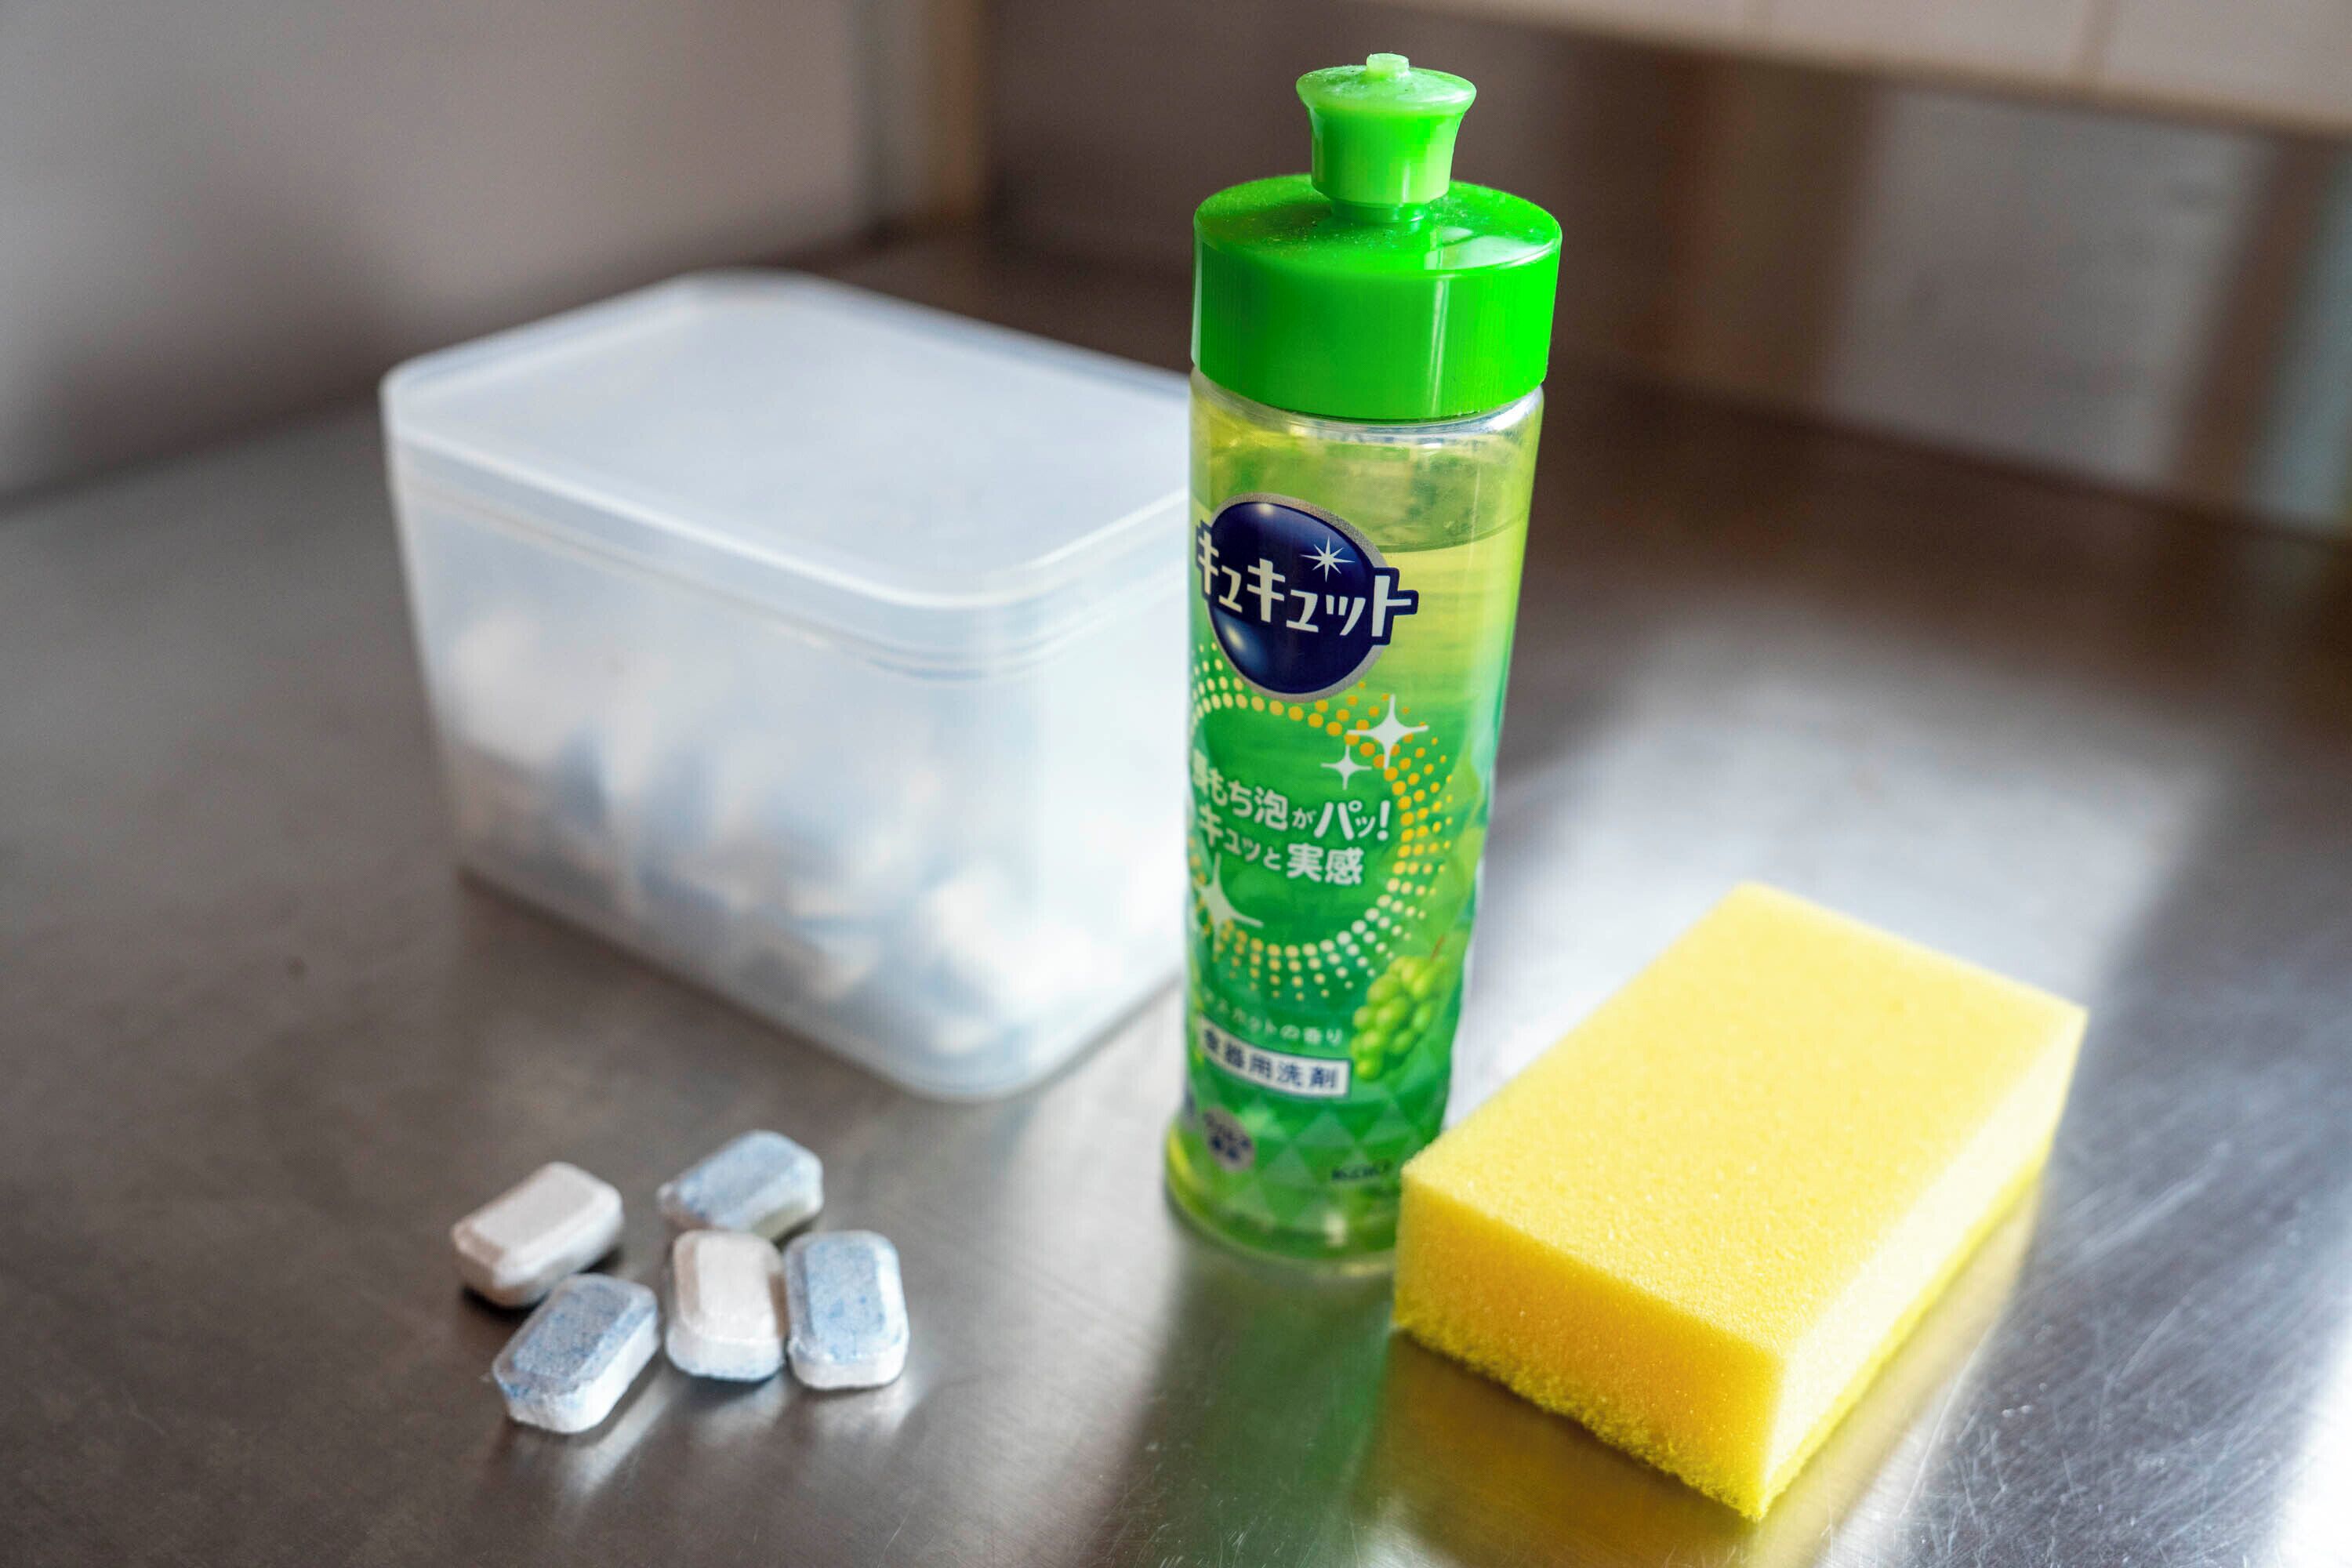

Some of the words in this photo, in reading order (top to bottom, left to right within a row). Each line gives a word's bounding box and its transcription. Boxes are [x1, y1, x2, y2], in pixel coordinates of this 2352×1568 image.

[1196, 530, 1412, 637] キュキュット
[1198, 803, 1365, 885] キュッと実感
